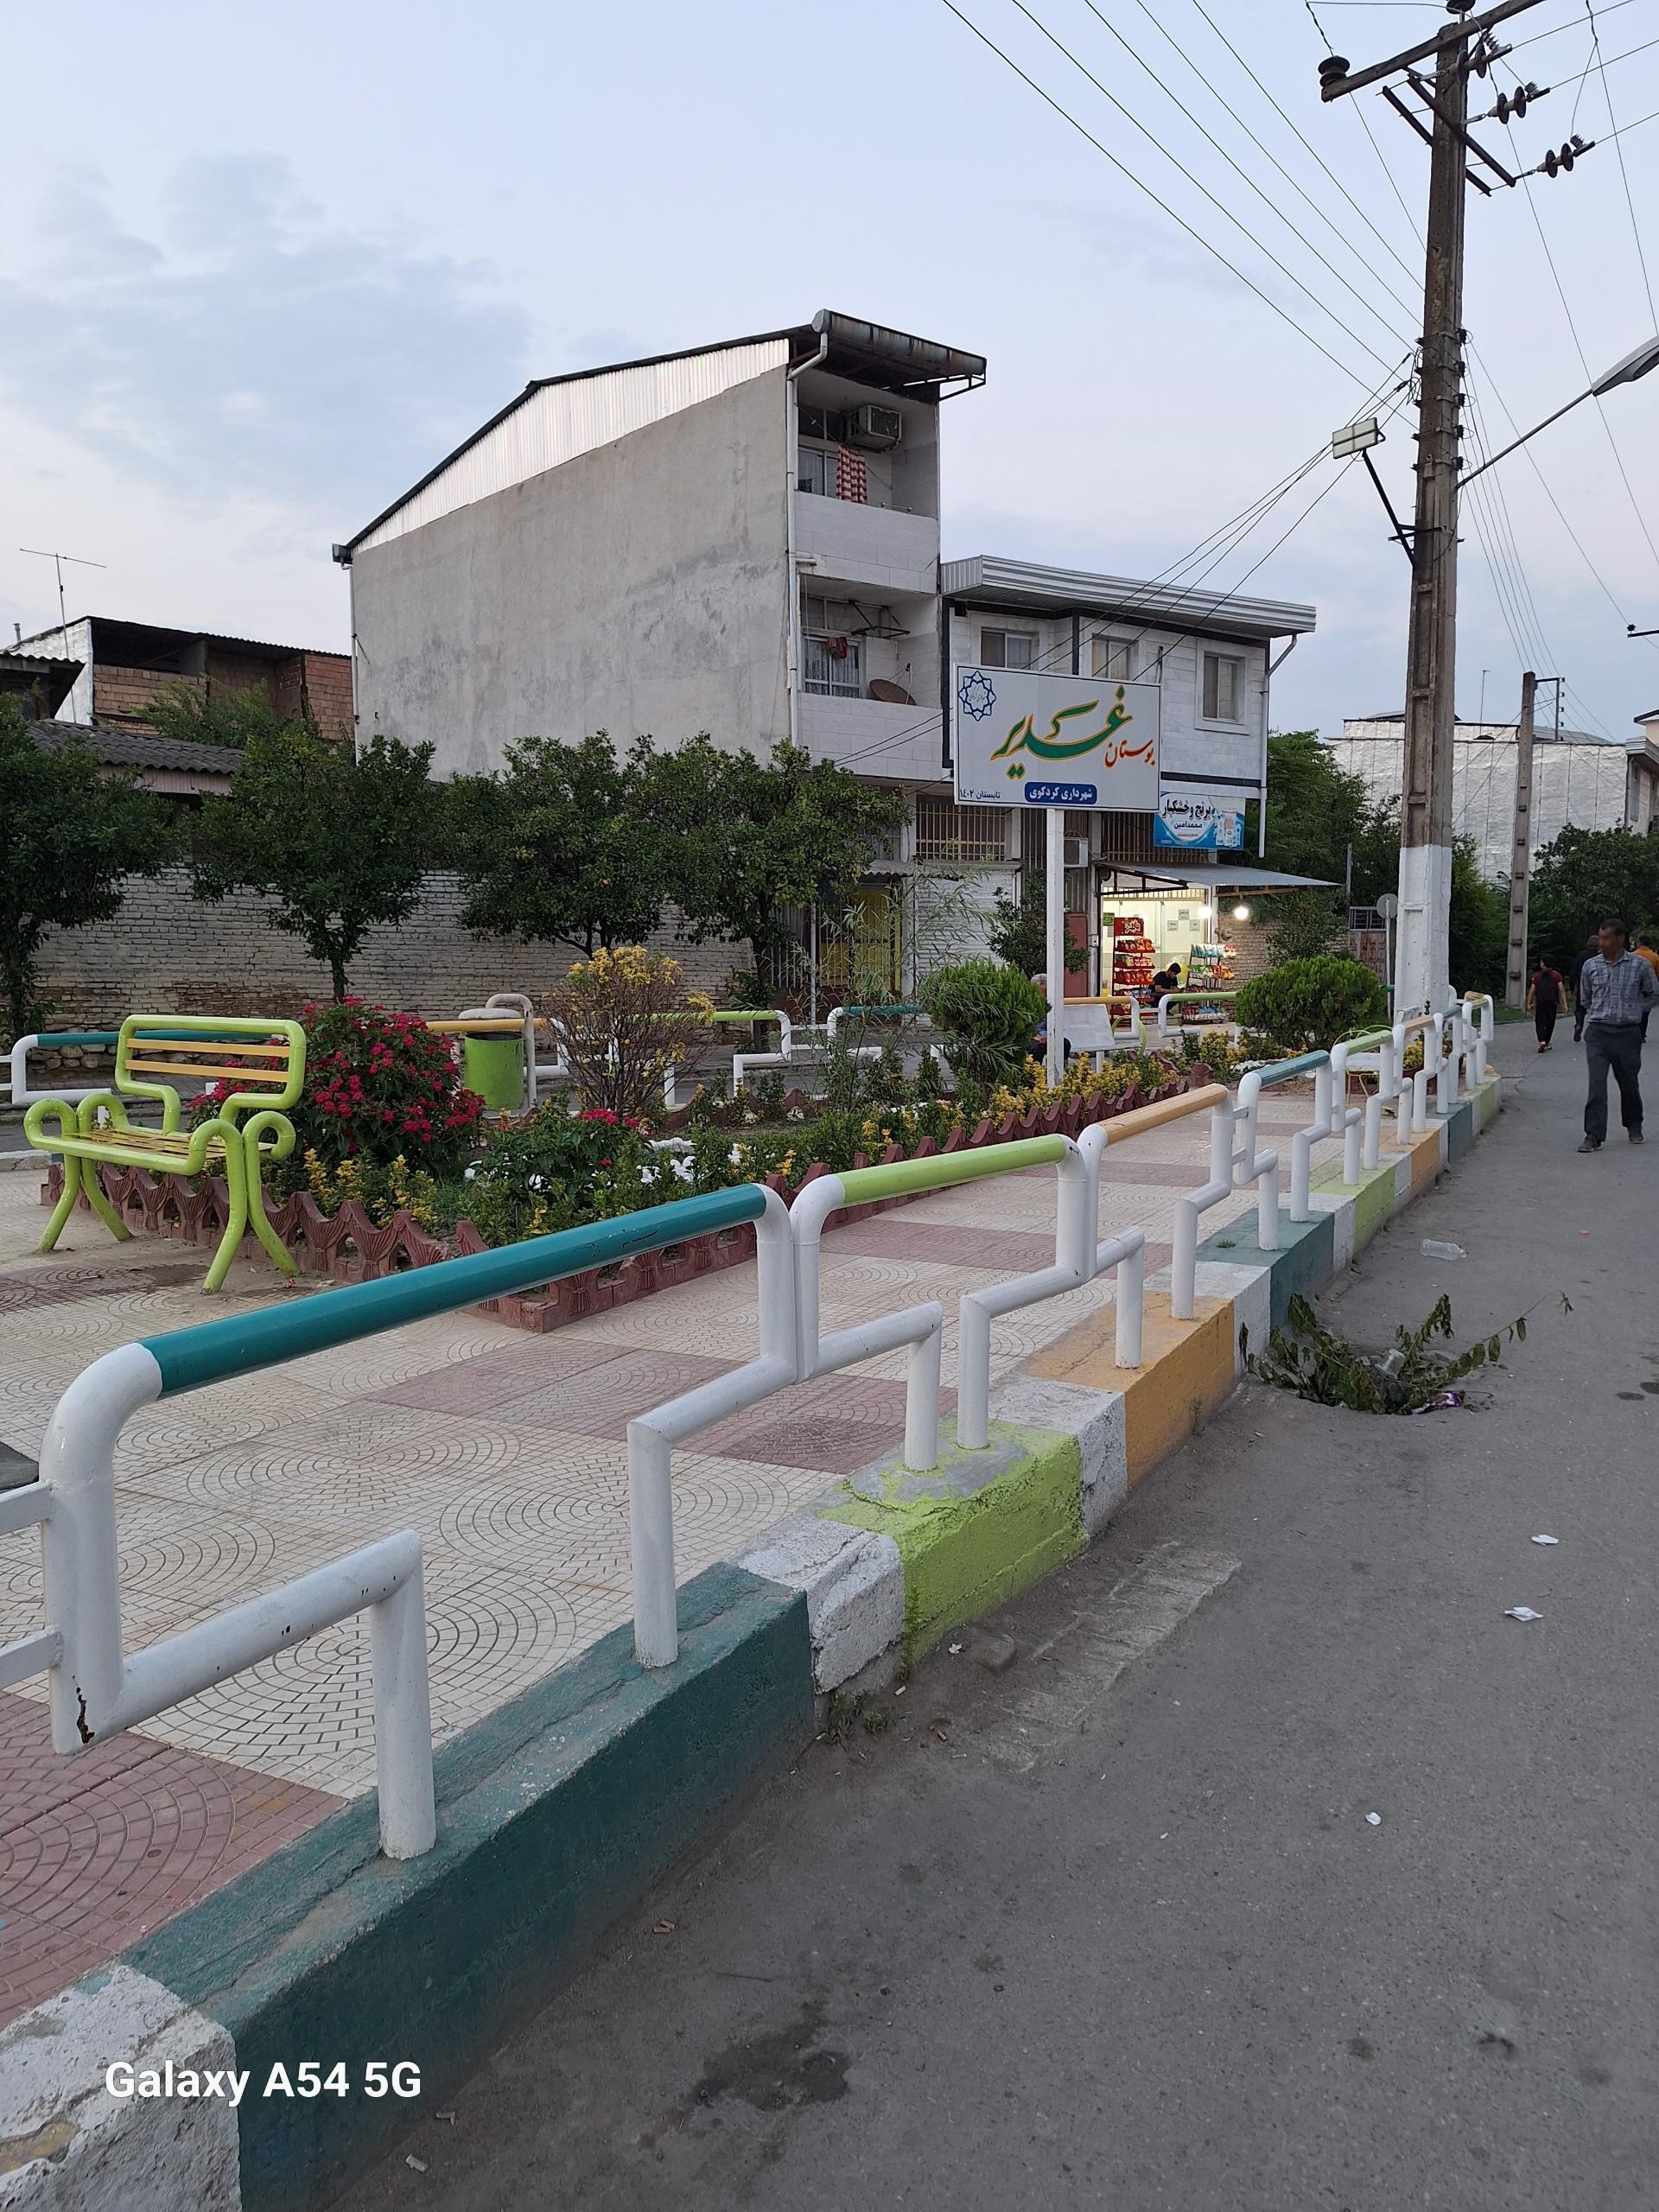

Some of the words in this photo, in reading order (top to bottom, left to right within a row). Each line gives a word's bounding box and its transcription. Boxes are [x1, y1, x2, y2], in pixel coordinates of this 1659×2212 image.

[989, 683, 1134, 780] غدیر
[1104, 739, 1156, 769] بوستان
[976, 790, 1001, 801] تابستان
[1029, 785, 1059, 800] کردکوی
[1060, 787, 1093, 801] شهرداری
[1195, 801, 1211, 820] برنج
